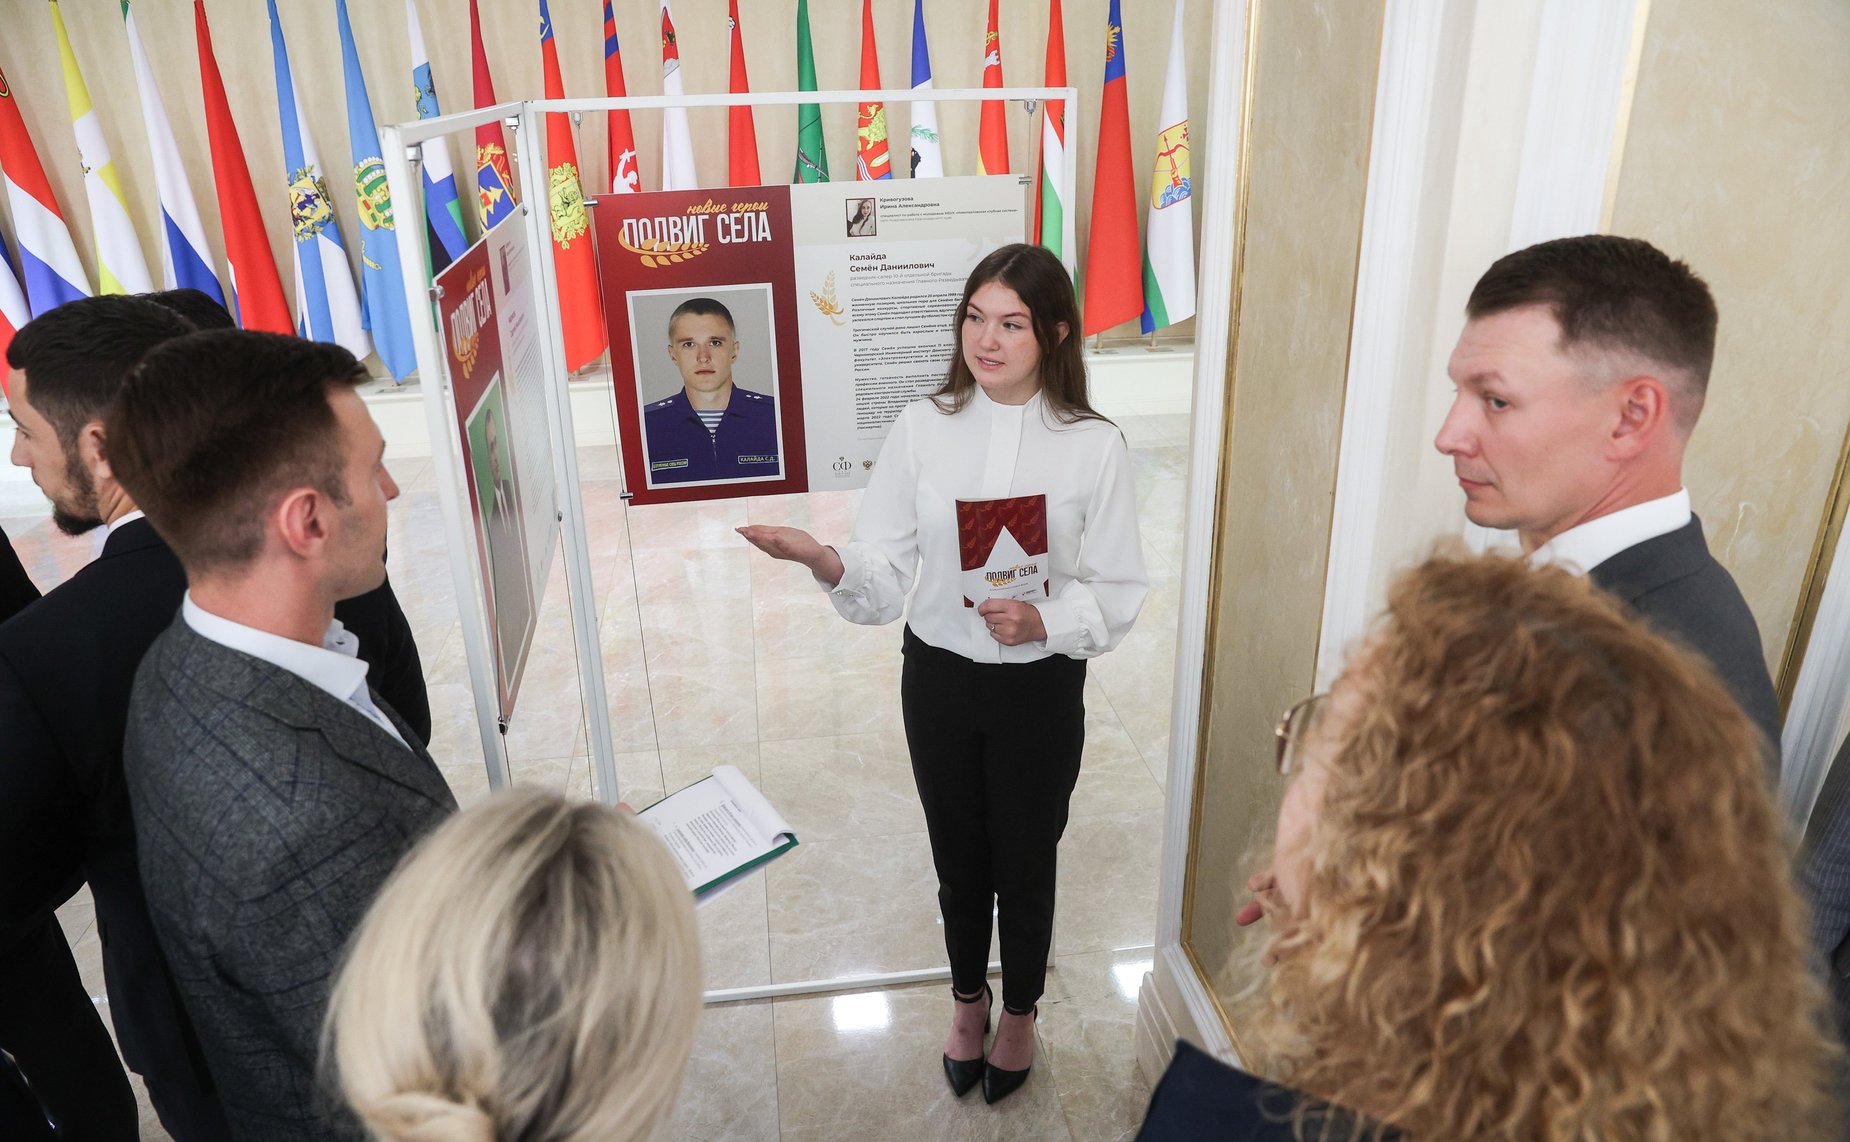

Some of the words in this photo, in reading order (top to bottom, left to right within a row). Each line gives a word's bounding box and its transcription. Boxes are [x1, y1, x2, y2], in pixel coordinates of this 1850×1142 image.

[687, 198, 727, 214] новые
[731, 201, 769, 217] герои
[622, 215, 709, 252] ПОДВИГ
[717, 211, 772, 244] СЕЛА
[880, 263, 935, 271] Даниилович
[986, 569, 1016, 581] ПОДВИГ
[1019, 565, 1038, 577] СЕЛА
